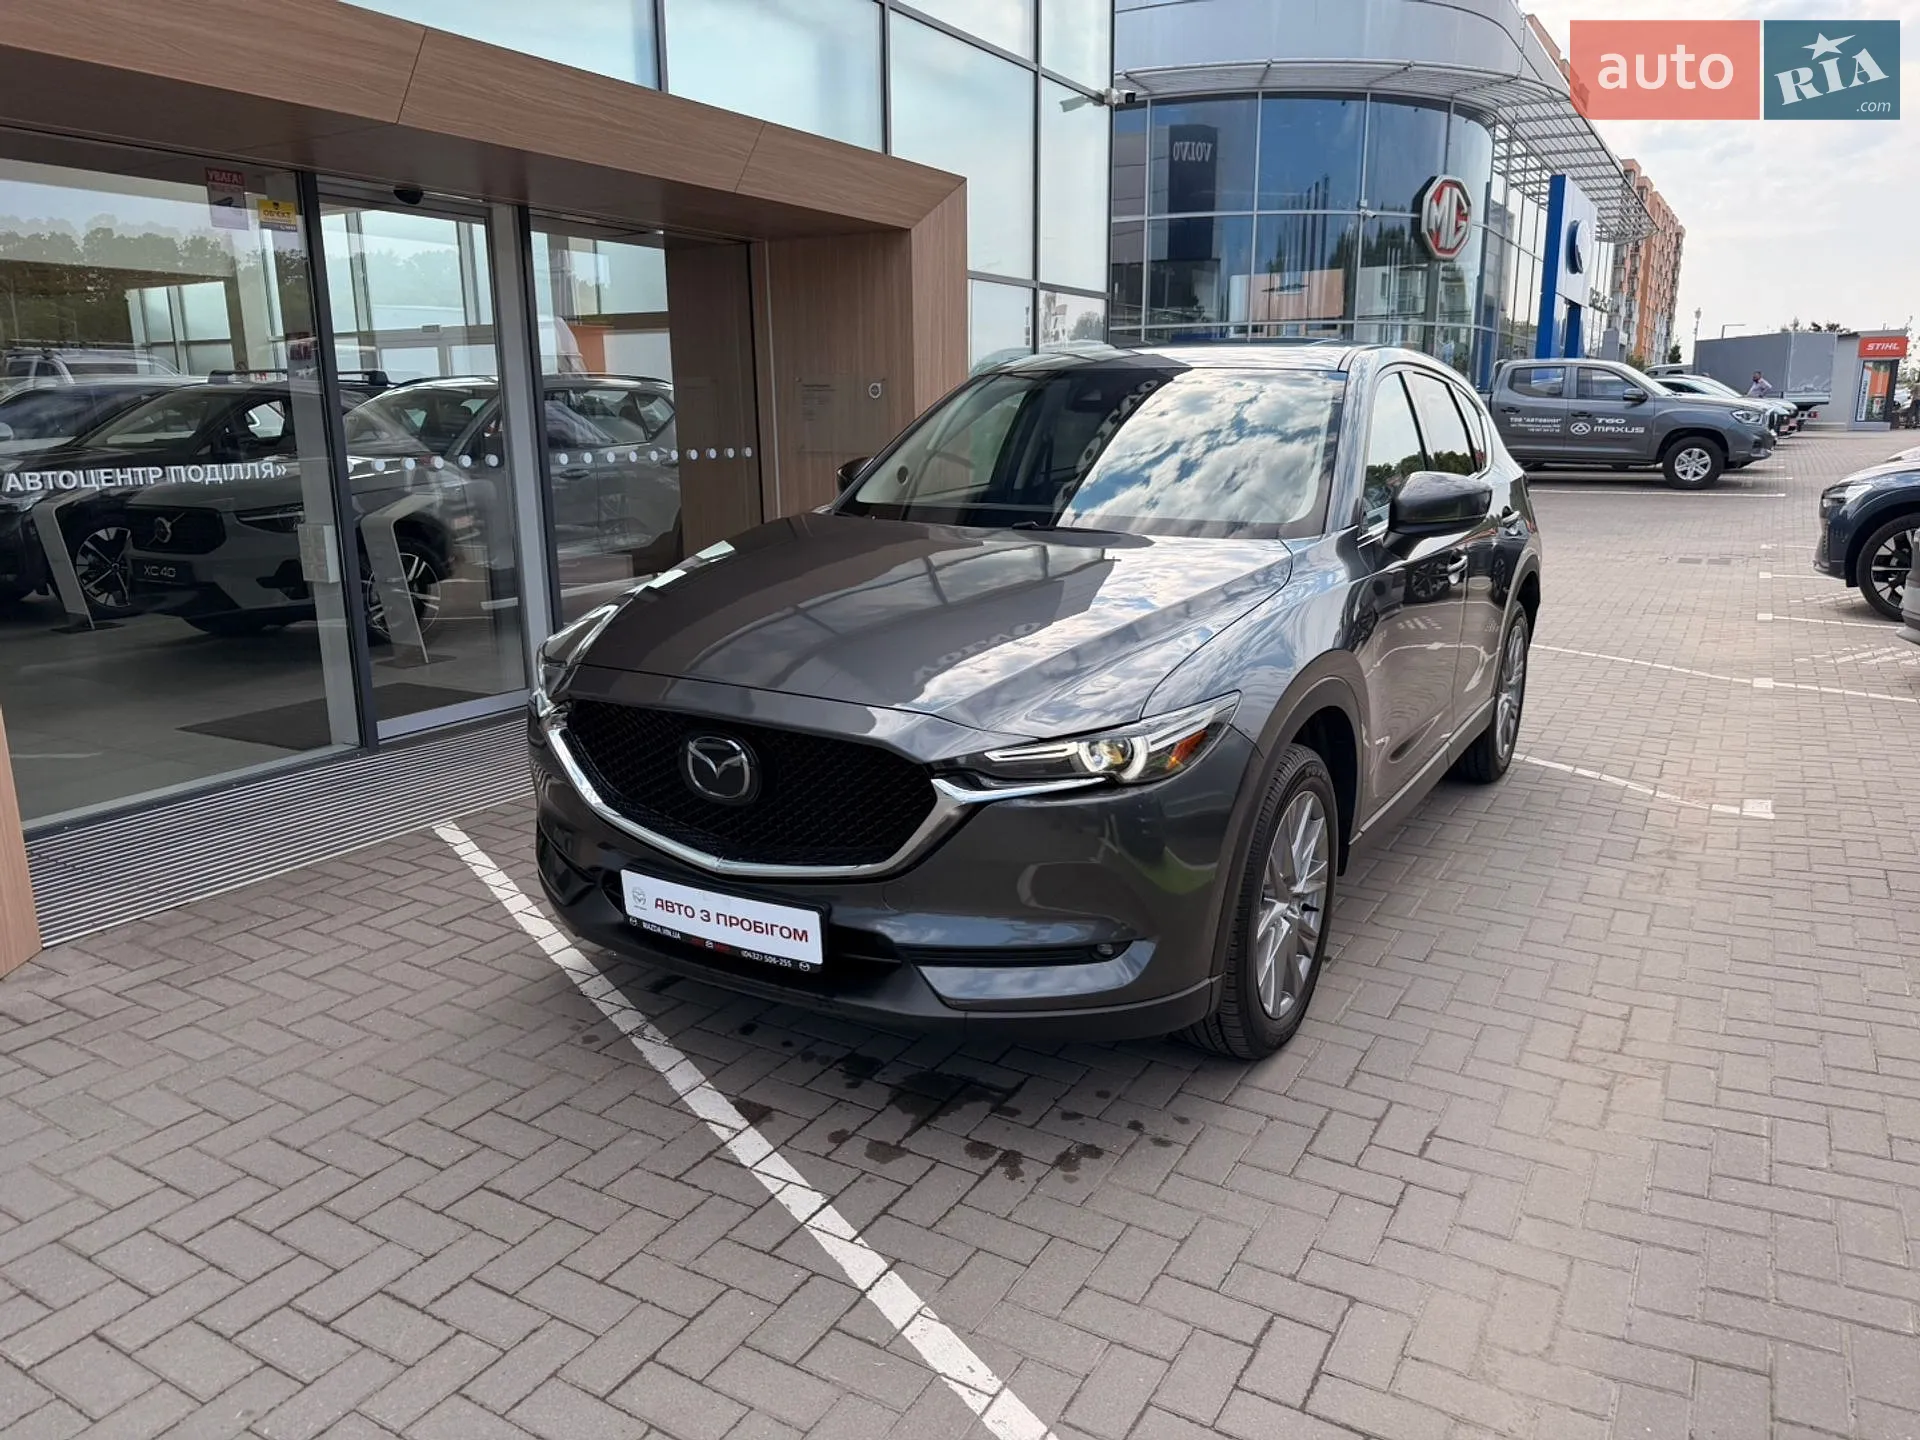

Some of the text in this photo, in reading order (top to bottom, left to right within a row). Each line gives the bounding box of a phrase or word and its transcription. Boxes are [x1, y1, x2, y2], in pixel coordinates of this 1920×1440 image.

[1428, 186, 1469, 250] MG
[1866, 342, 1900, 351] STIHL
[1593, 425, 1645, 434] MAXUS
[3, 461, 288, 493] АВТОЦЕНТР ПОДІЛЛЯ»
[654, 897, 809, 943] АВТО З ПРОБІГОМ
